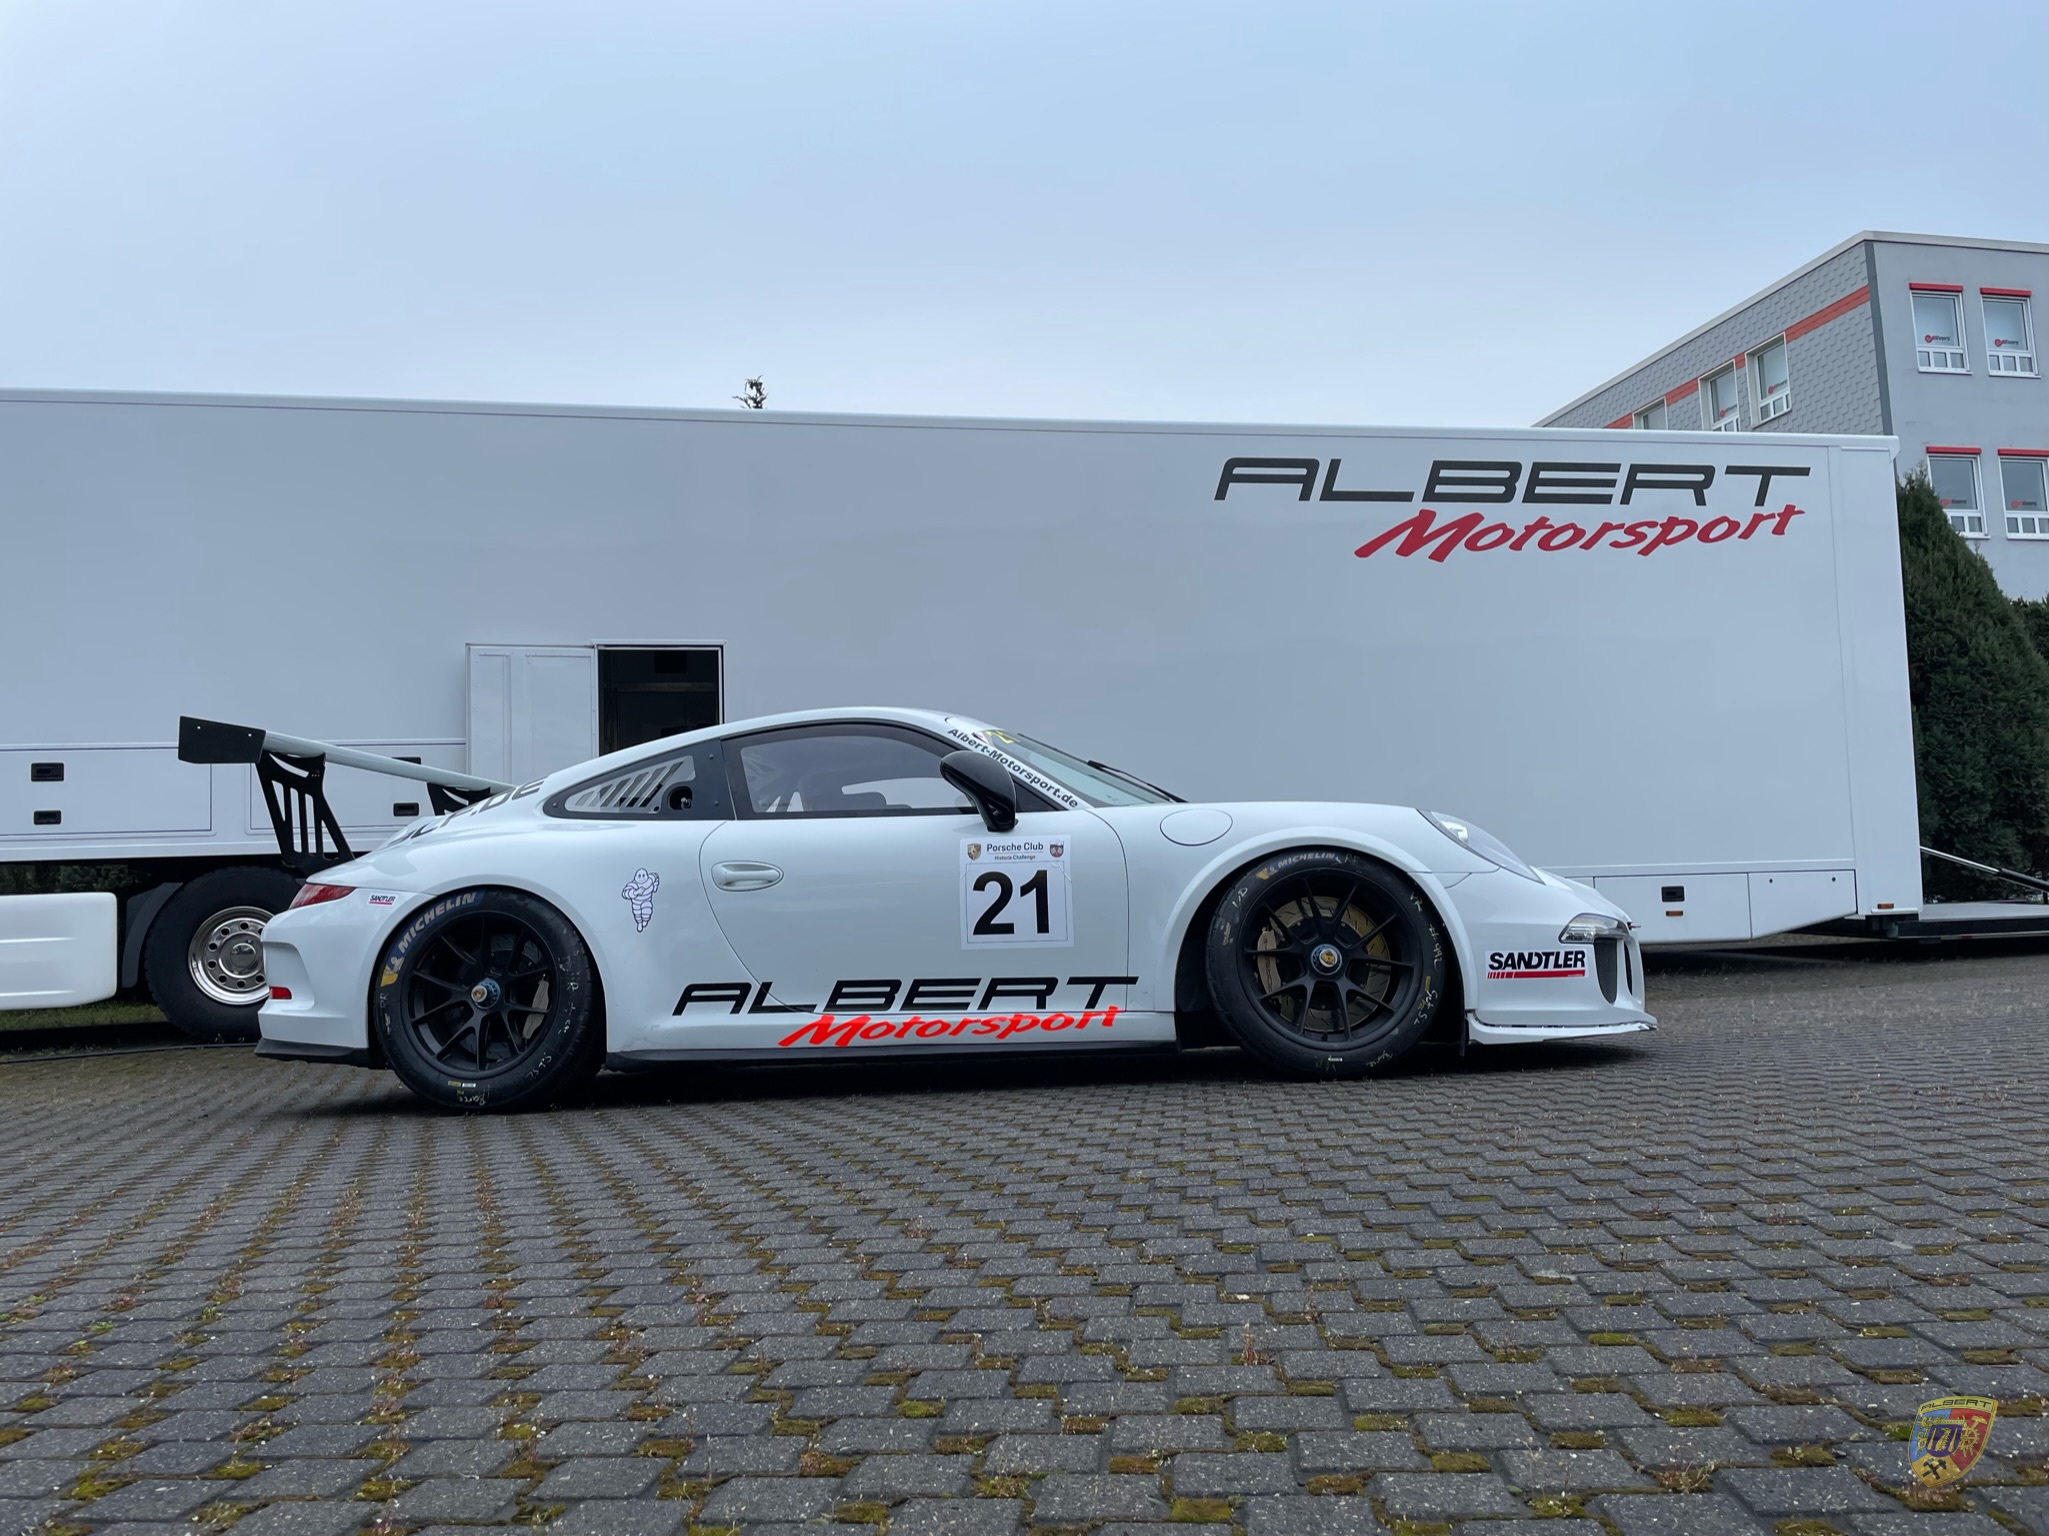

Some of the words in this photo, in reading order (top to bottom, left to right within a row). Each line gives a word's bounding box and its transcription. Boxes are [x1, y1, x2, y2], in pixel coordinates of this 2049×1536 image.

[1214, 456, 1811, 507] ALBERT
[1354, 503, 1805, 563] Motorsport
[947, 728, 1079, 808] Albert-Motorsport.de
[986, 843, 1022, 853] Porsche
[1023, 841, 1044, 851] Club
[1277, 852, 1336, 869] MICHELIN
[397, 891, 477, 954] MICHELIN
[973, 869, 1050, 936] 21
[1488, 950, 1586, 970] SANDTLER
[672, 976, 1139, 1016] ALBERT
[778, 1004, 1128, 1048] Motorsport
